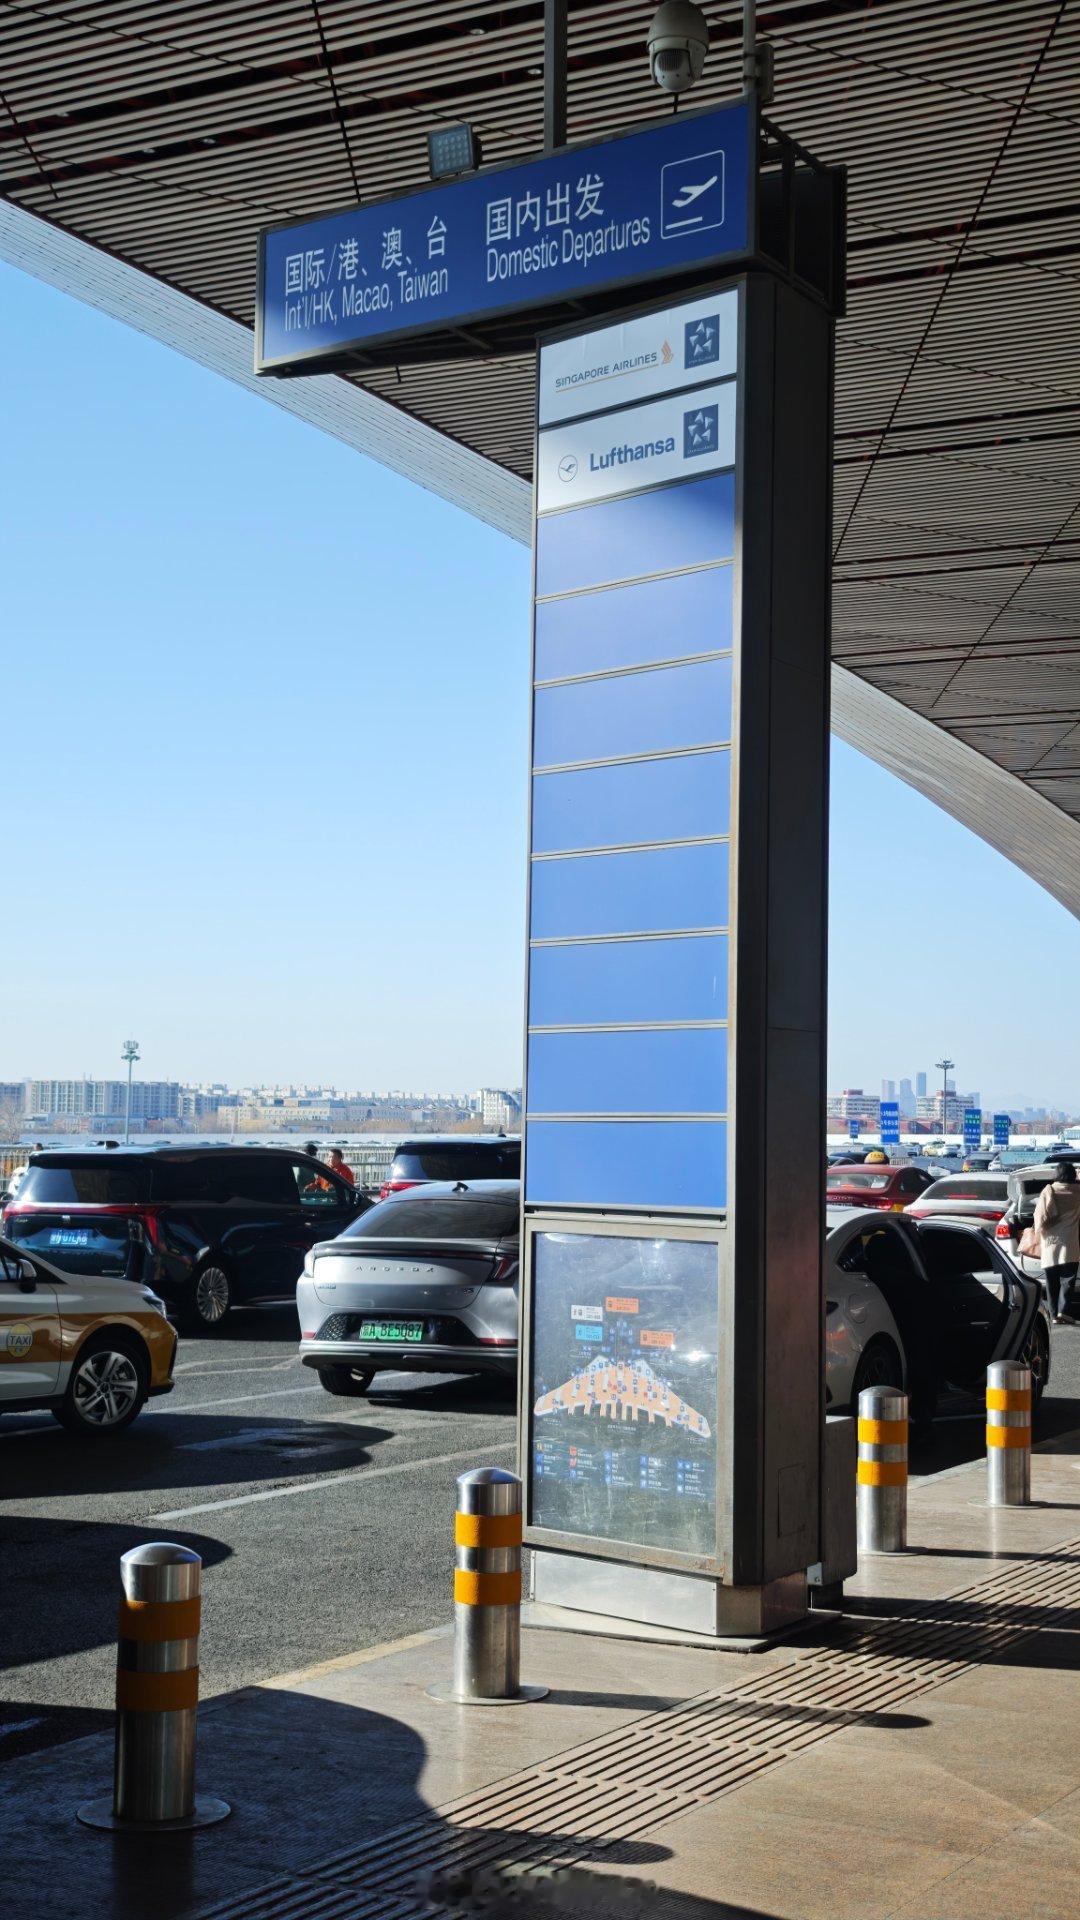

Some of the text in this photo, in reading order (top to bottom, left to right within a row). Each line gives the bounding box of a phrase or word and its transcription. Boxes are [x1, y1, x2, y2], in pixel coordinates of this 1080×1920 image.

[486, 173, 604, 245] 国内出发
[486, 216, 650, 283] Domestic Departures
[342, 283, 394, 318] Macao,
[397, 267, 449, 304] Taiwan
[555, 352, 657, 388] SINGAPORE AIRLINES
[590, 437, 675, 472] Lufthansa
[9, 1335, 32, 1346] TAXI
